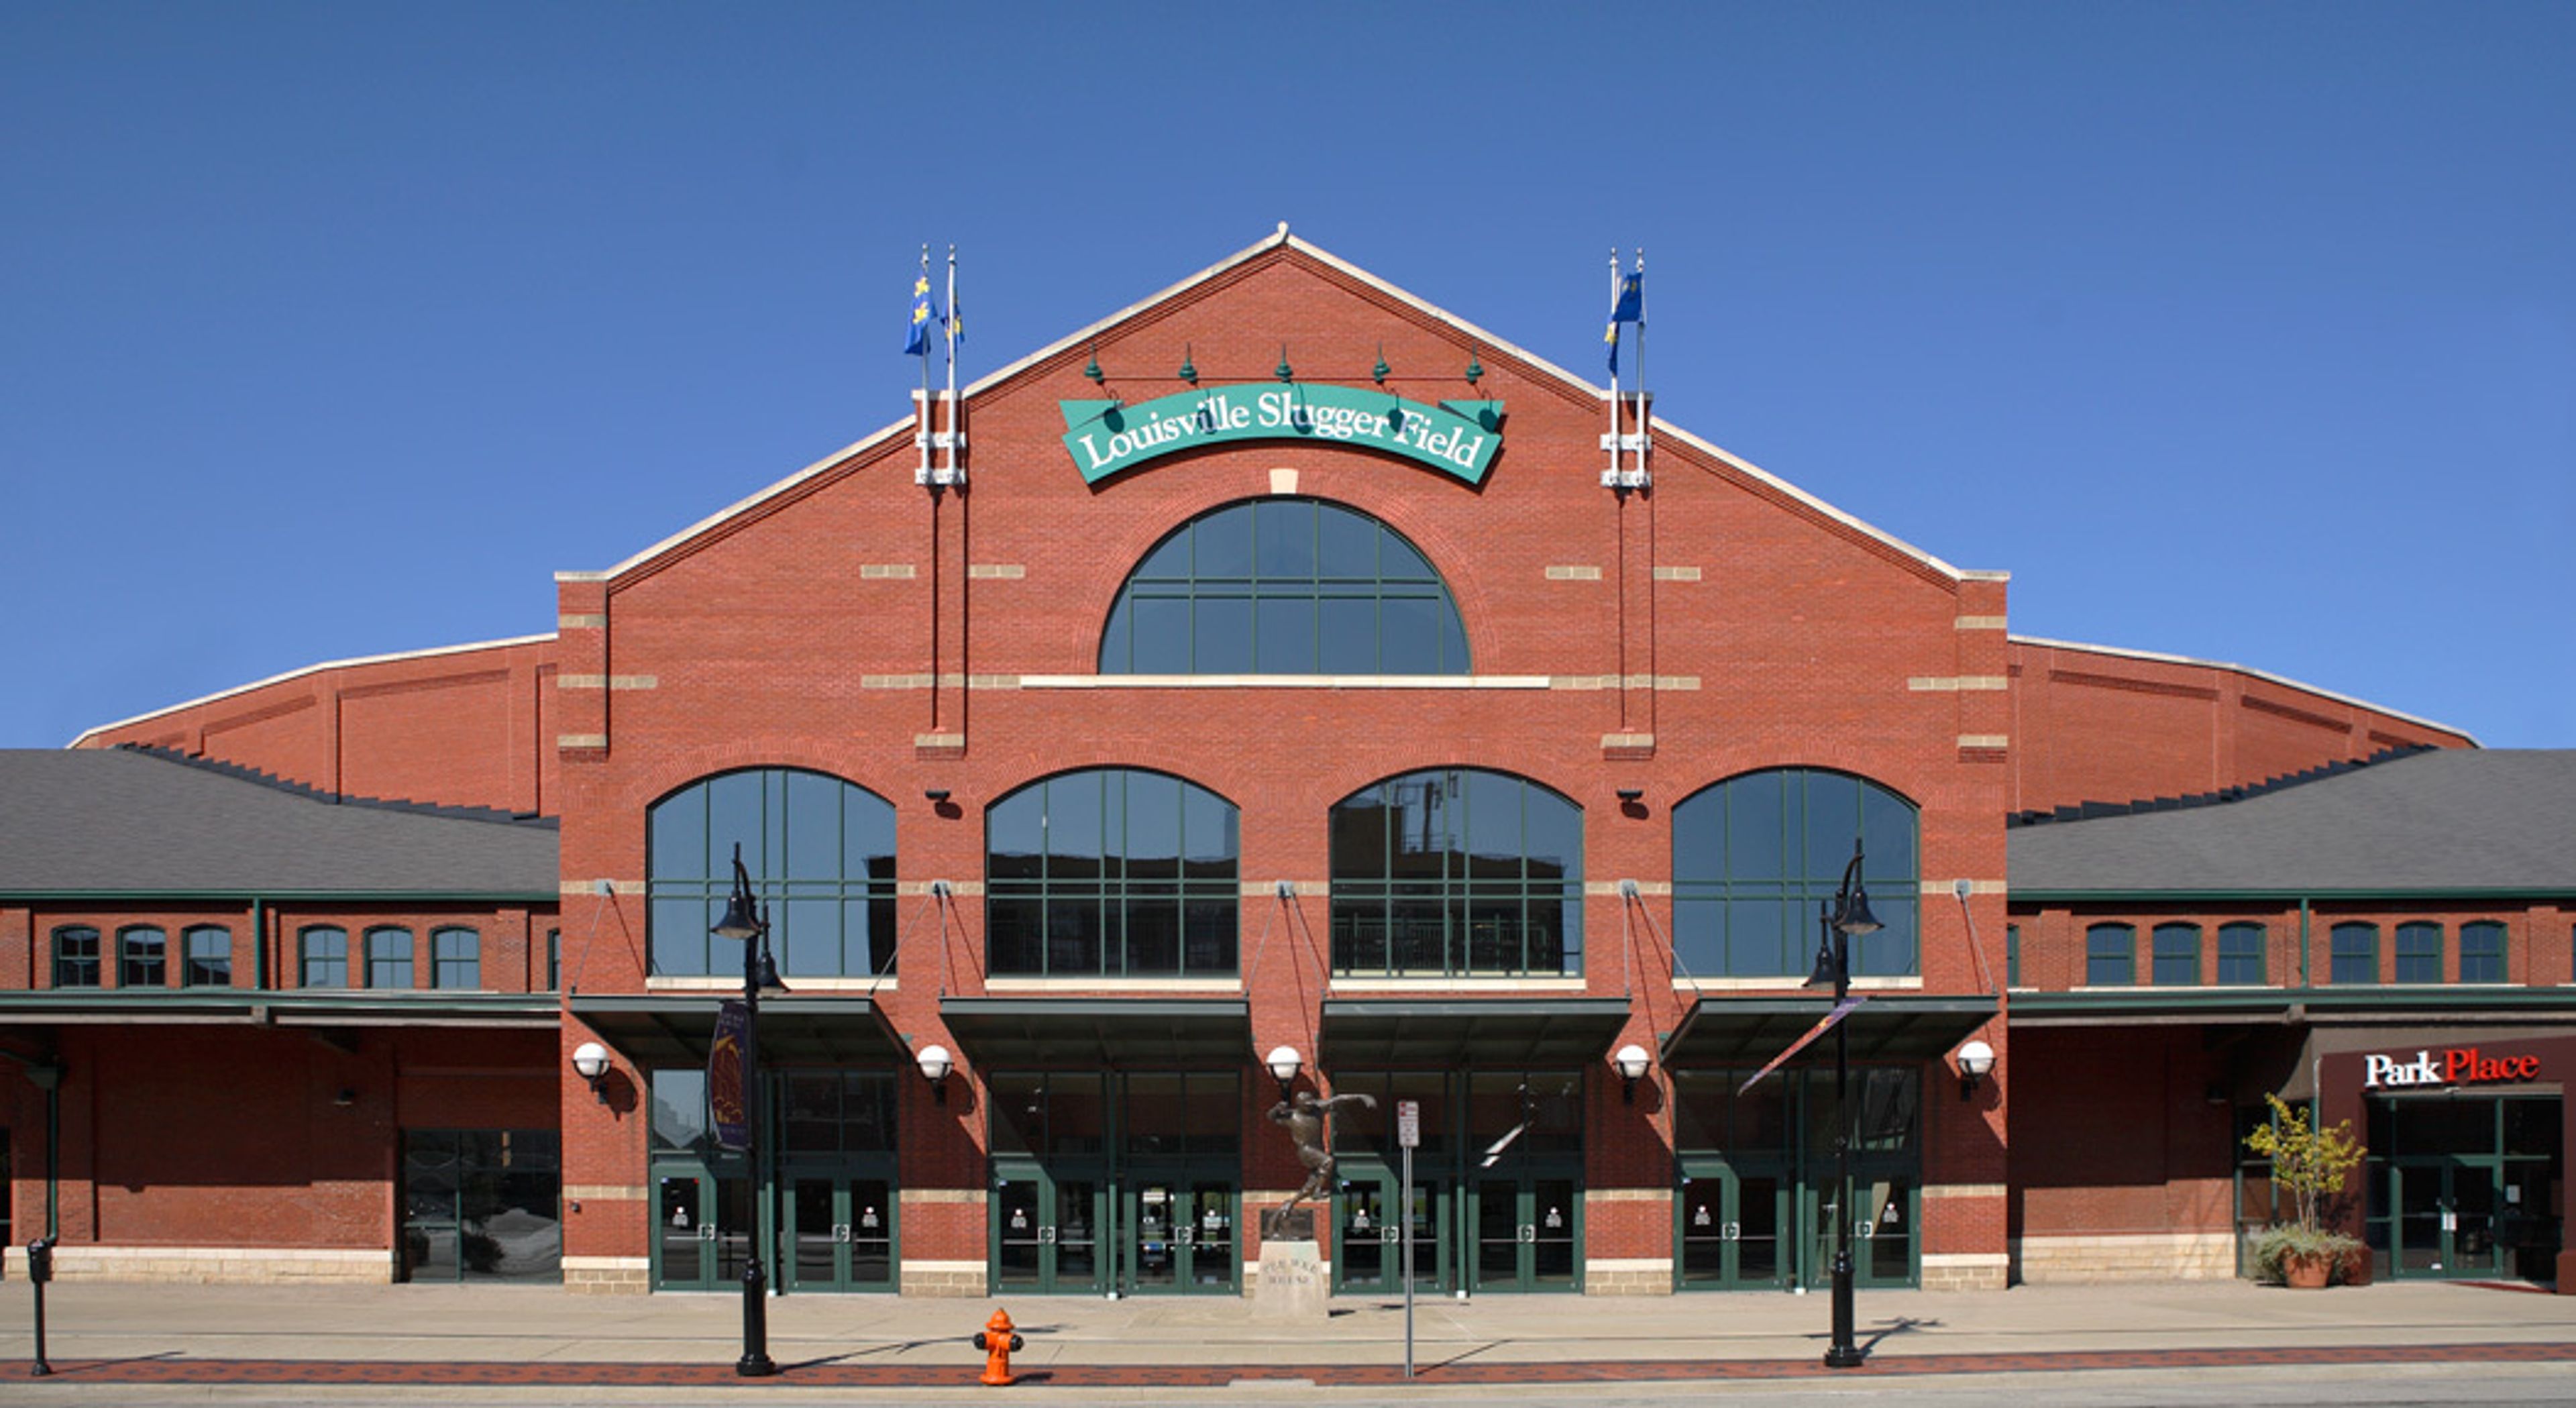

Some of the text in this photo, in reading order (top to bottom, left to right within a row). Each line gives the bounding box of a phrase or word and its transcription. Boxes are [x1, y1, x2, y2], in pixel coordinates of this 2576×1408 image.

[1078, 391, 1485, 470] Louisville Slugger Field
[2365, 1047, 2540, 1087] Park Place
